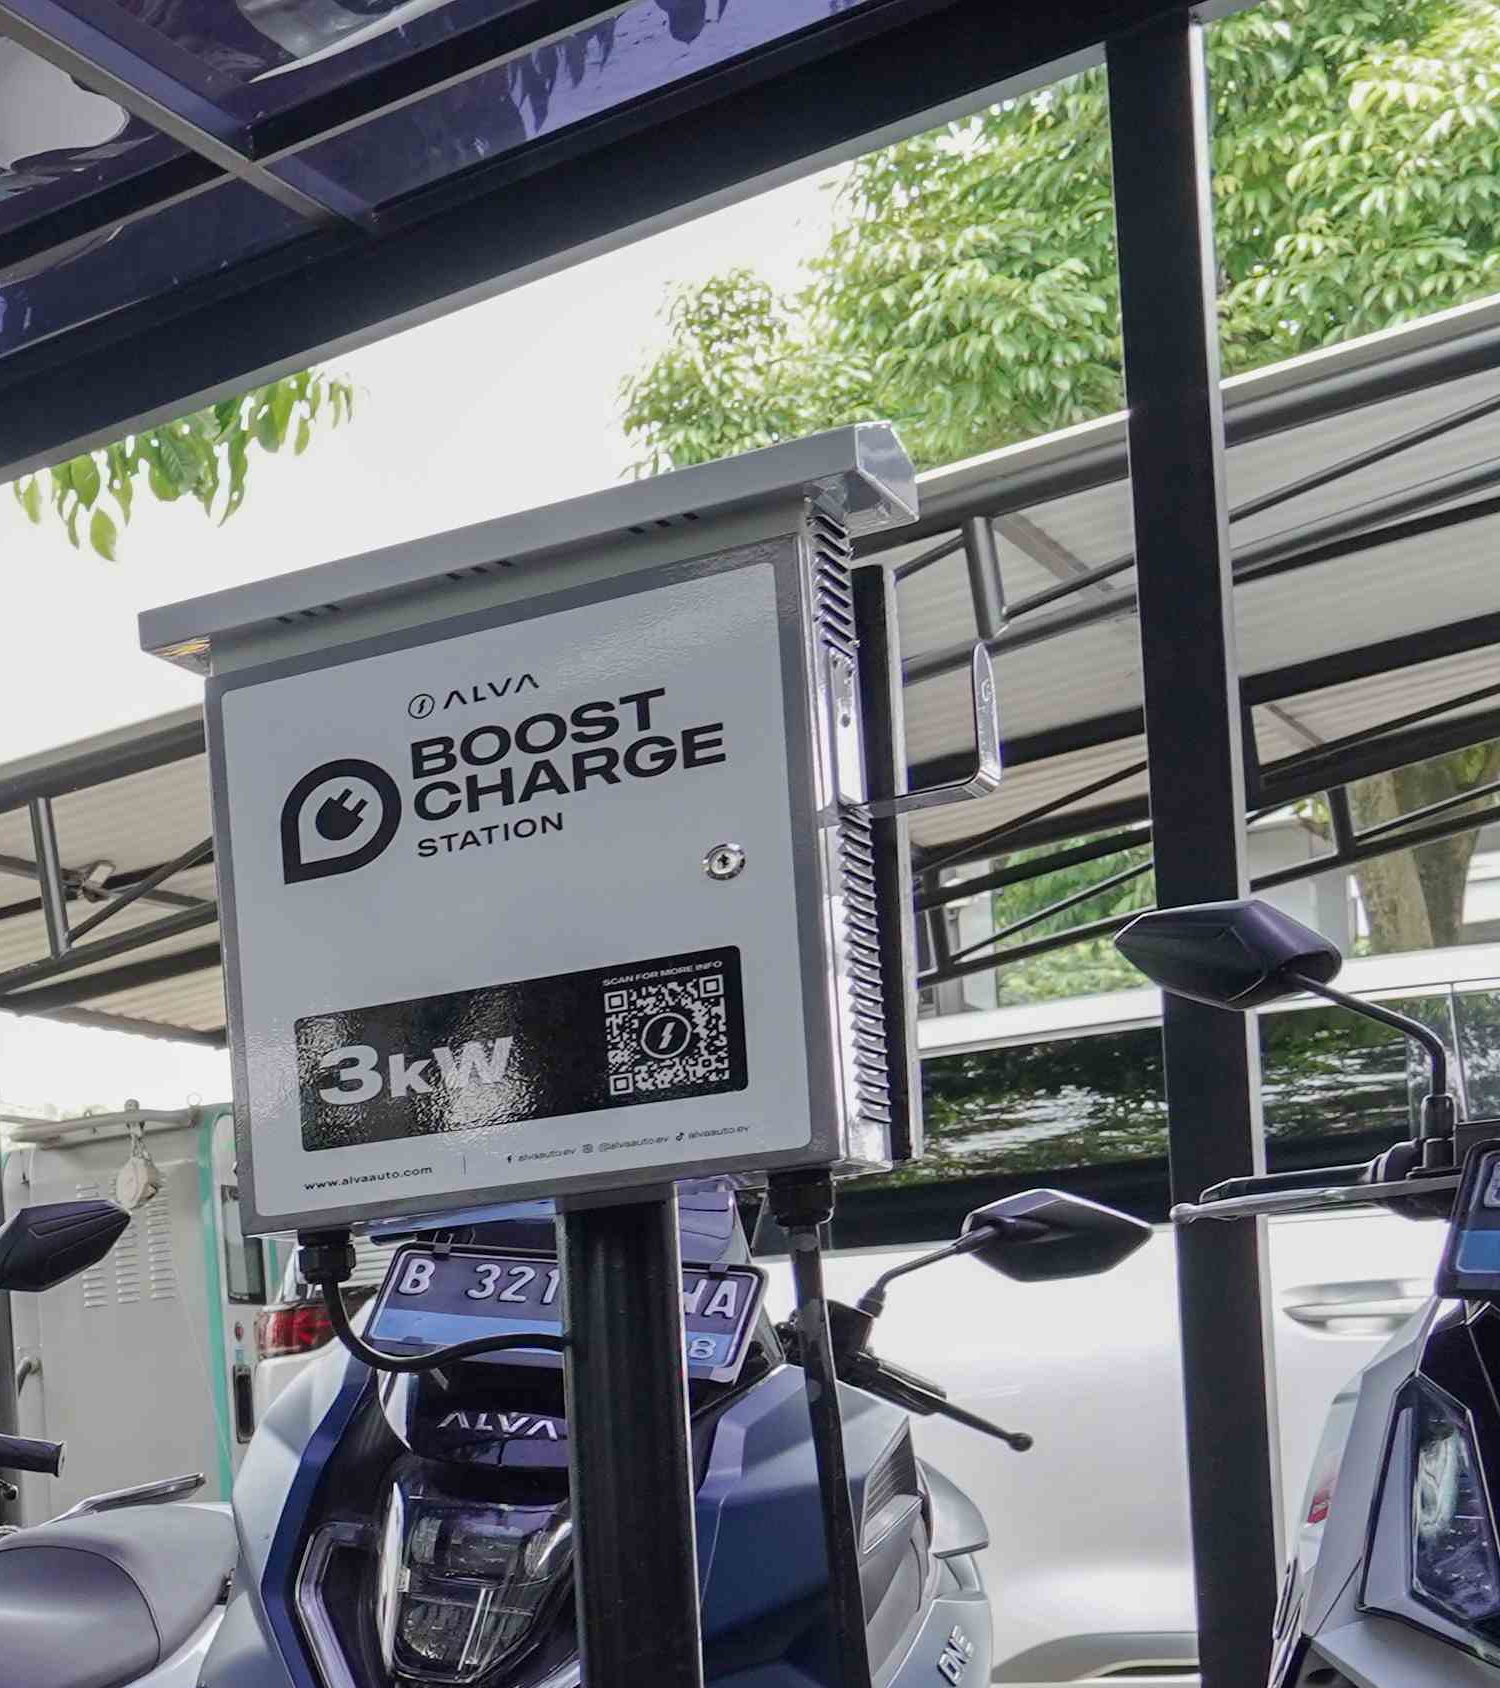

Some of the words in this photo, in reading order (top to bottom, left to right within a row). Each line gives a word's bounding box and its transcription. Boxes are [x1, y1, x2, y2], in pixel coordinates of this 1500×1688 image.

[443, 672, 541, 710] ALVA
[410, 686, 666, 780] BOOST
[413, 721, 728, 822] CHARGE
[417, 811, 564, 858] STATION
[602, 974, 634, 987] SCAN
[635, 970, 659, 981] FOR
[660, 964, 694, 977] MORE
[303, 1164, 433, 1191] www.alvaauto.com
[398, 1258, 437, 1296] B
[464, 1263, 561, 1305] 321
[436, 1409, 559, 1442] ALVA
